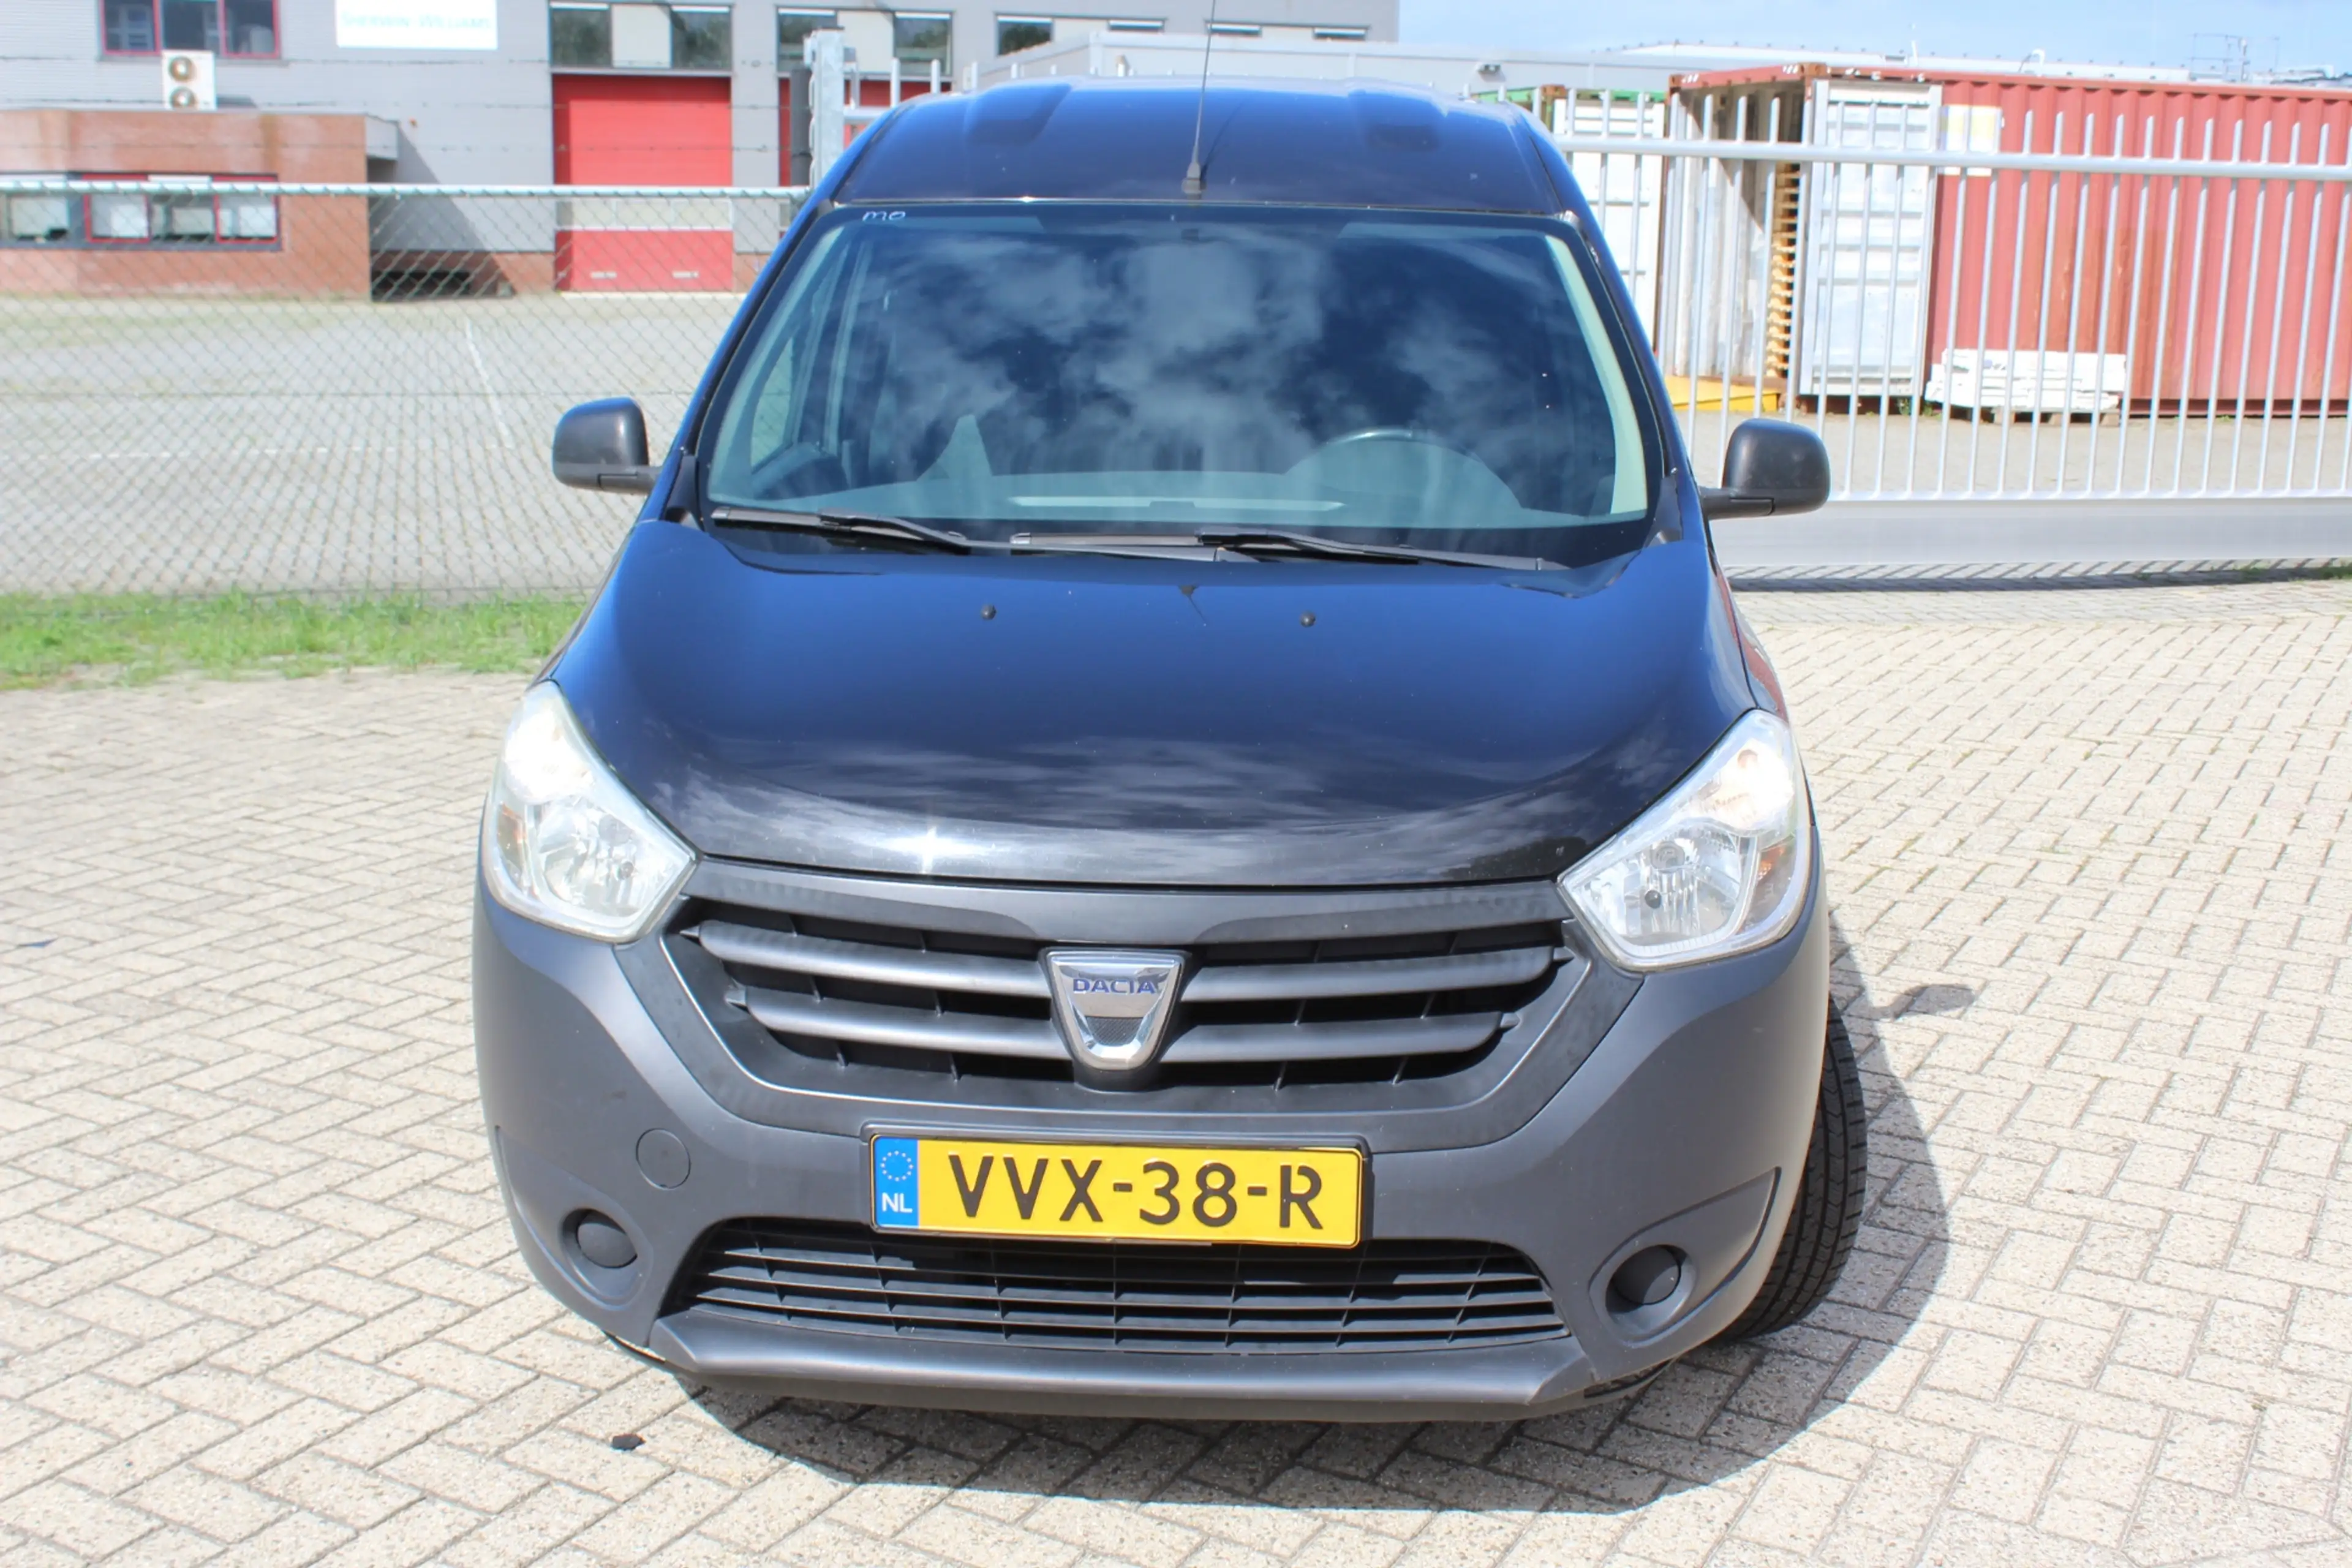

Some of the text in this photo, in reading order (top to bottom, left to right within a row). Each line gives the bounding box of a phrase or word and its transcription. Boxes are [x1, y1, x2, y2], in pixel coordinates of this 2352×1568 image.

[1072, 978, 1156, 994] DACIA
[881, 1152, 1324, 1230] NL VVX-38-R
